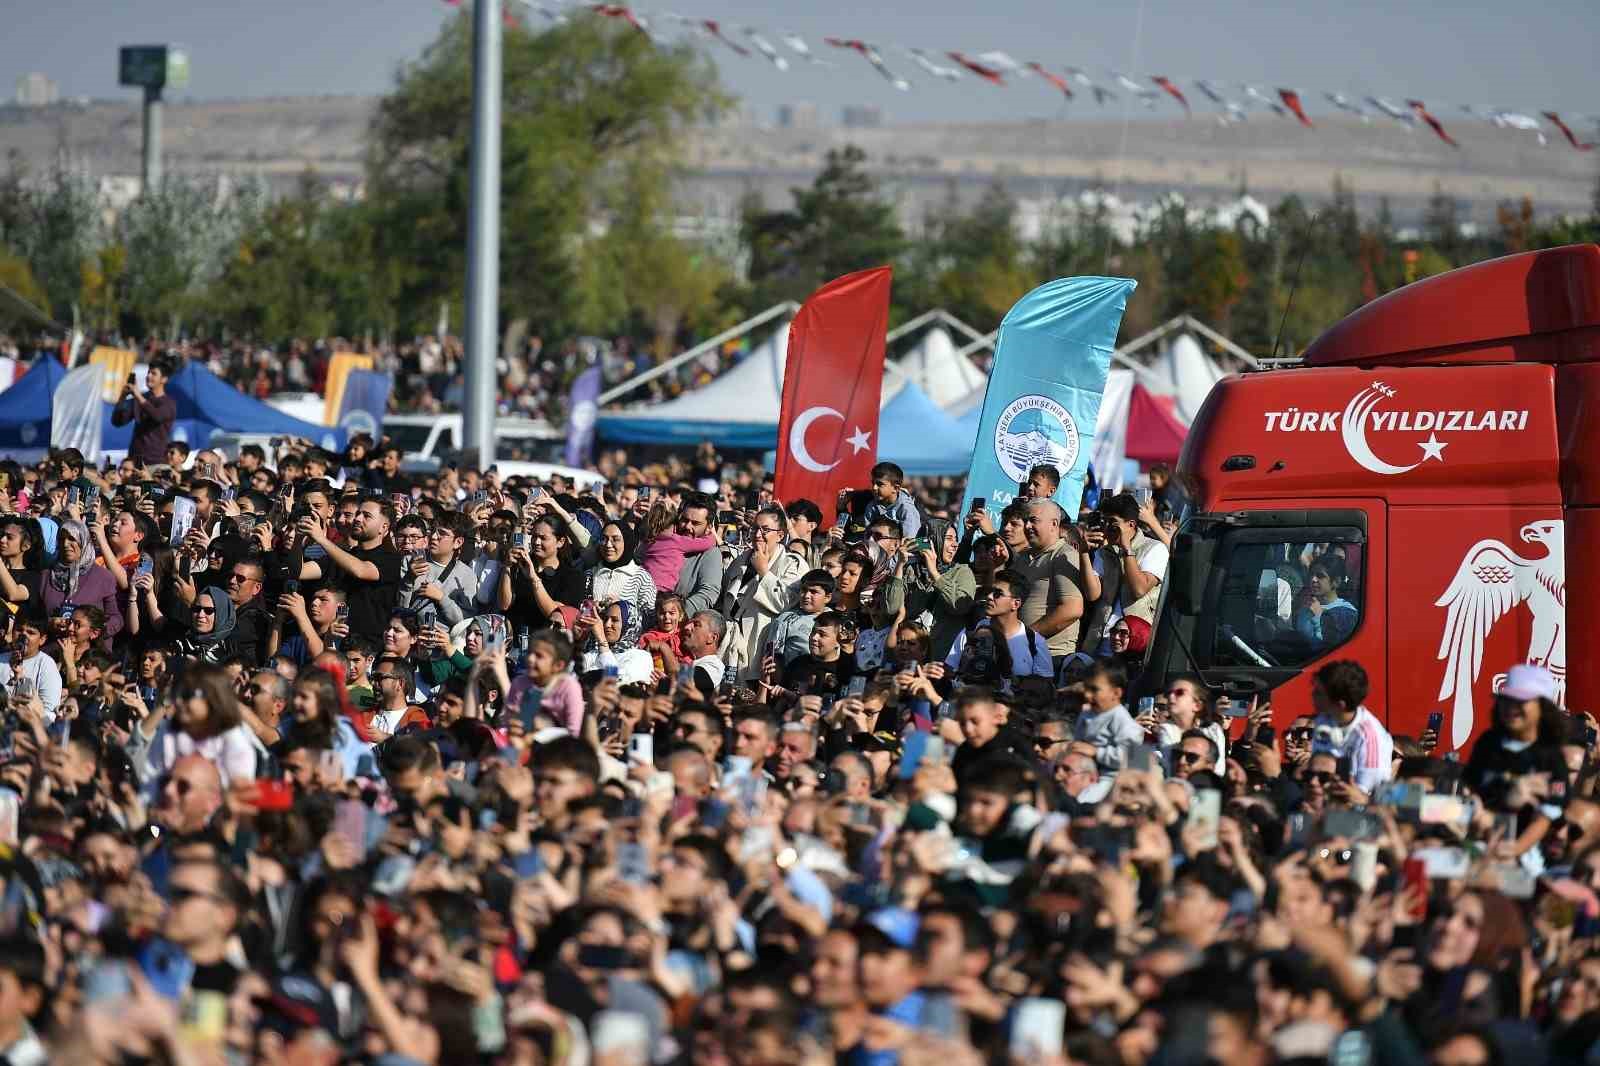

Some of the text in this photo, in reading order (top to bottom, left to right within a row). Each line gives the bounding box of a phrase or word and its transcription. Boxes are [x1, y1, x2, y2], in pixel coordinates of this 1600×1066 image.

[999, 411, 1013, 454] KAYSERİ
[1012, 398, 1064, 418] BÜYÜKŞEHİR
[1264, 407, 1529, 432] TÜRK YILDIZLARI
